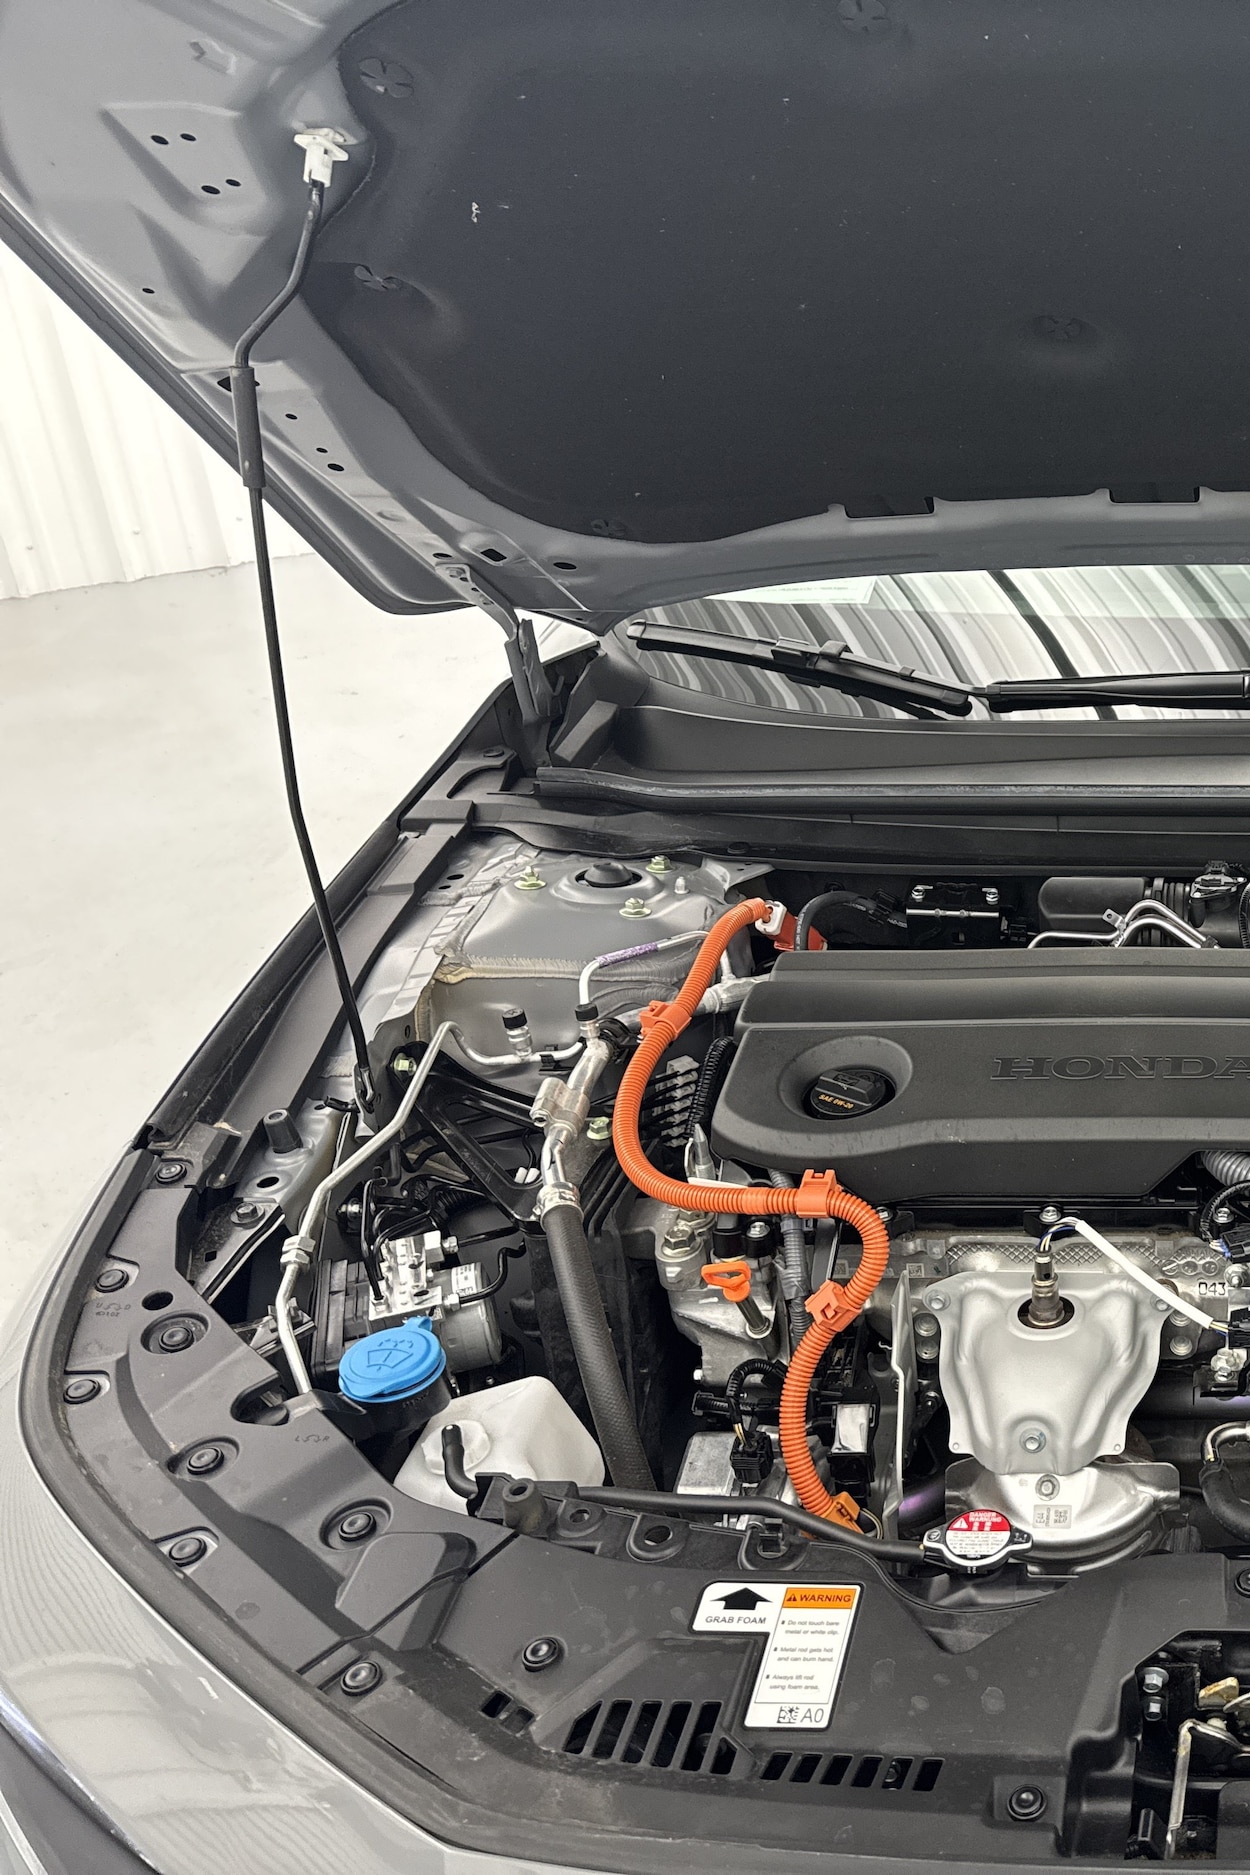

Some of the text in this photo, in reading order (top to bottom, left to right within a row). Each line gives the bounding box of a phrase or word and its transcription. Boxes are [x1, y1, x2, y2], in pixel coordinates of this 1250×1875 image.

[799, 1594, 851, 1603] WARNING
[705, 1615, 767, 1624] GRAB FOAM
[800, 1708, 824, 1723] A0
